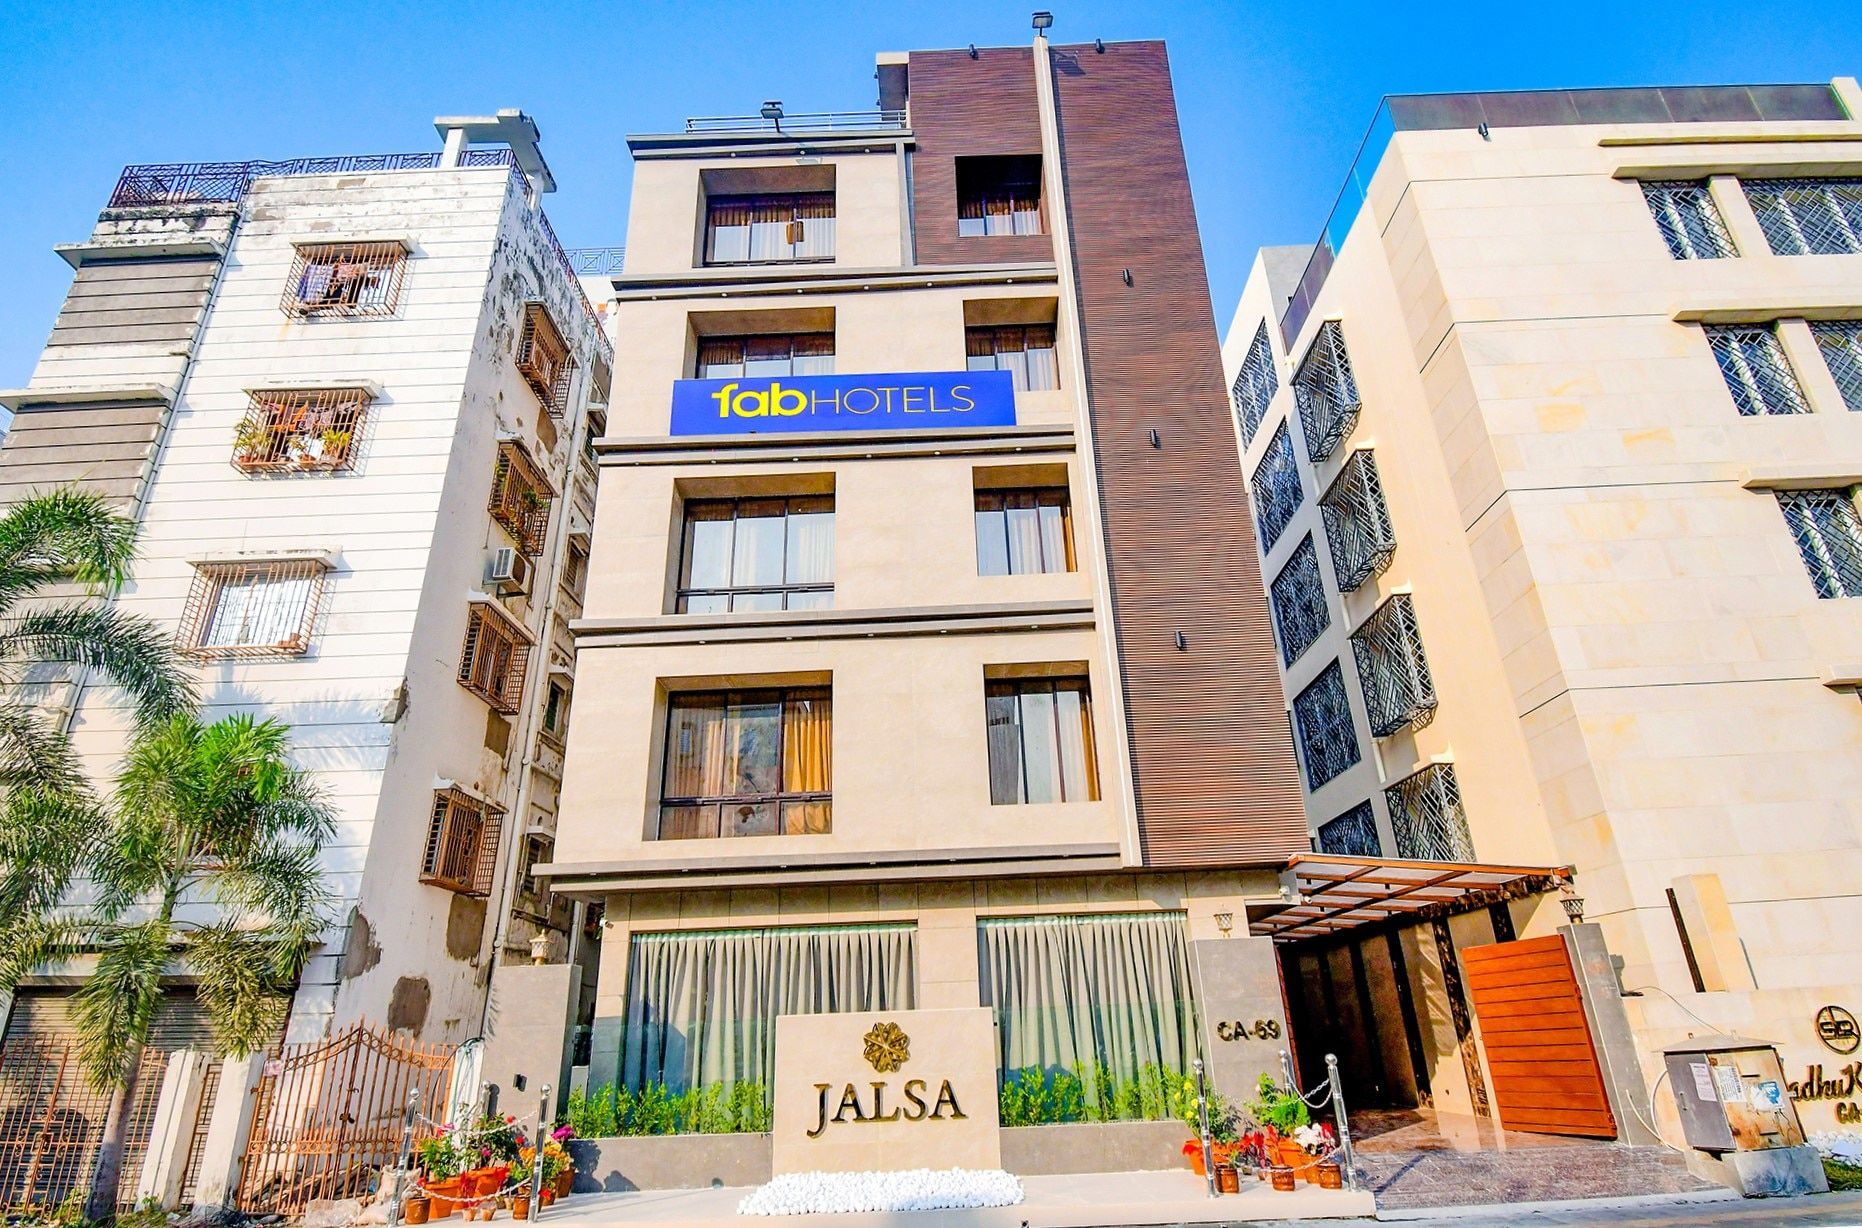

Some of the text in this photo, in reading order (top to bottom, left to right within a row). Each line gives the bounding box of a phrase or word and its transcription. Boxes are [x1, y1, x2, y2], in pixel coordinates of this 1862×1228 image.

[711, 382, 975, 418] fabHOTELS
[1217, 1019, 1281, 1041] CA-69
[806, 1079, 968, 1138] JALSA
